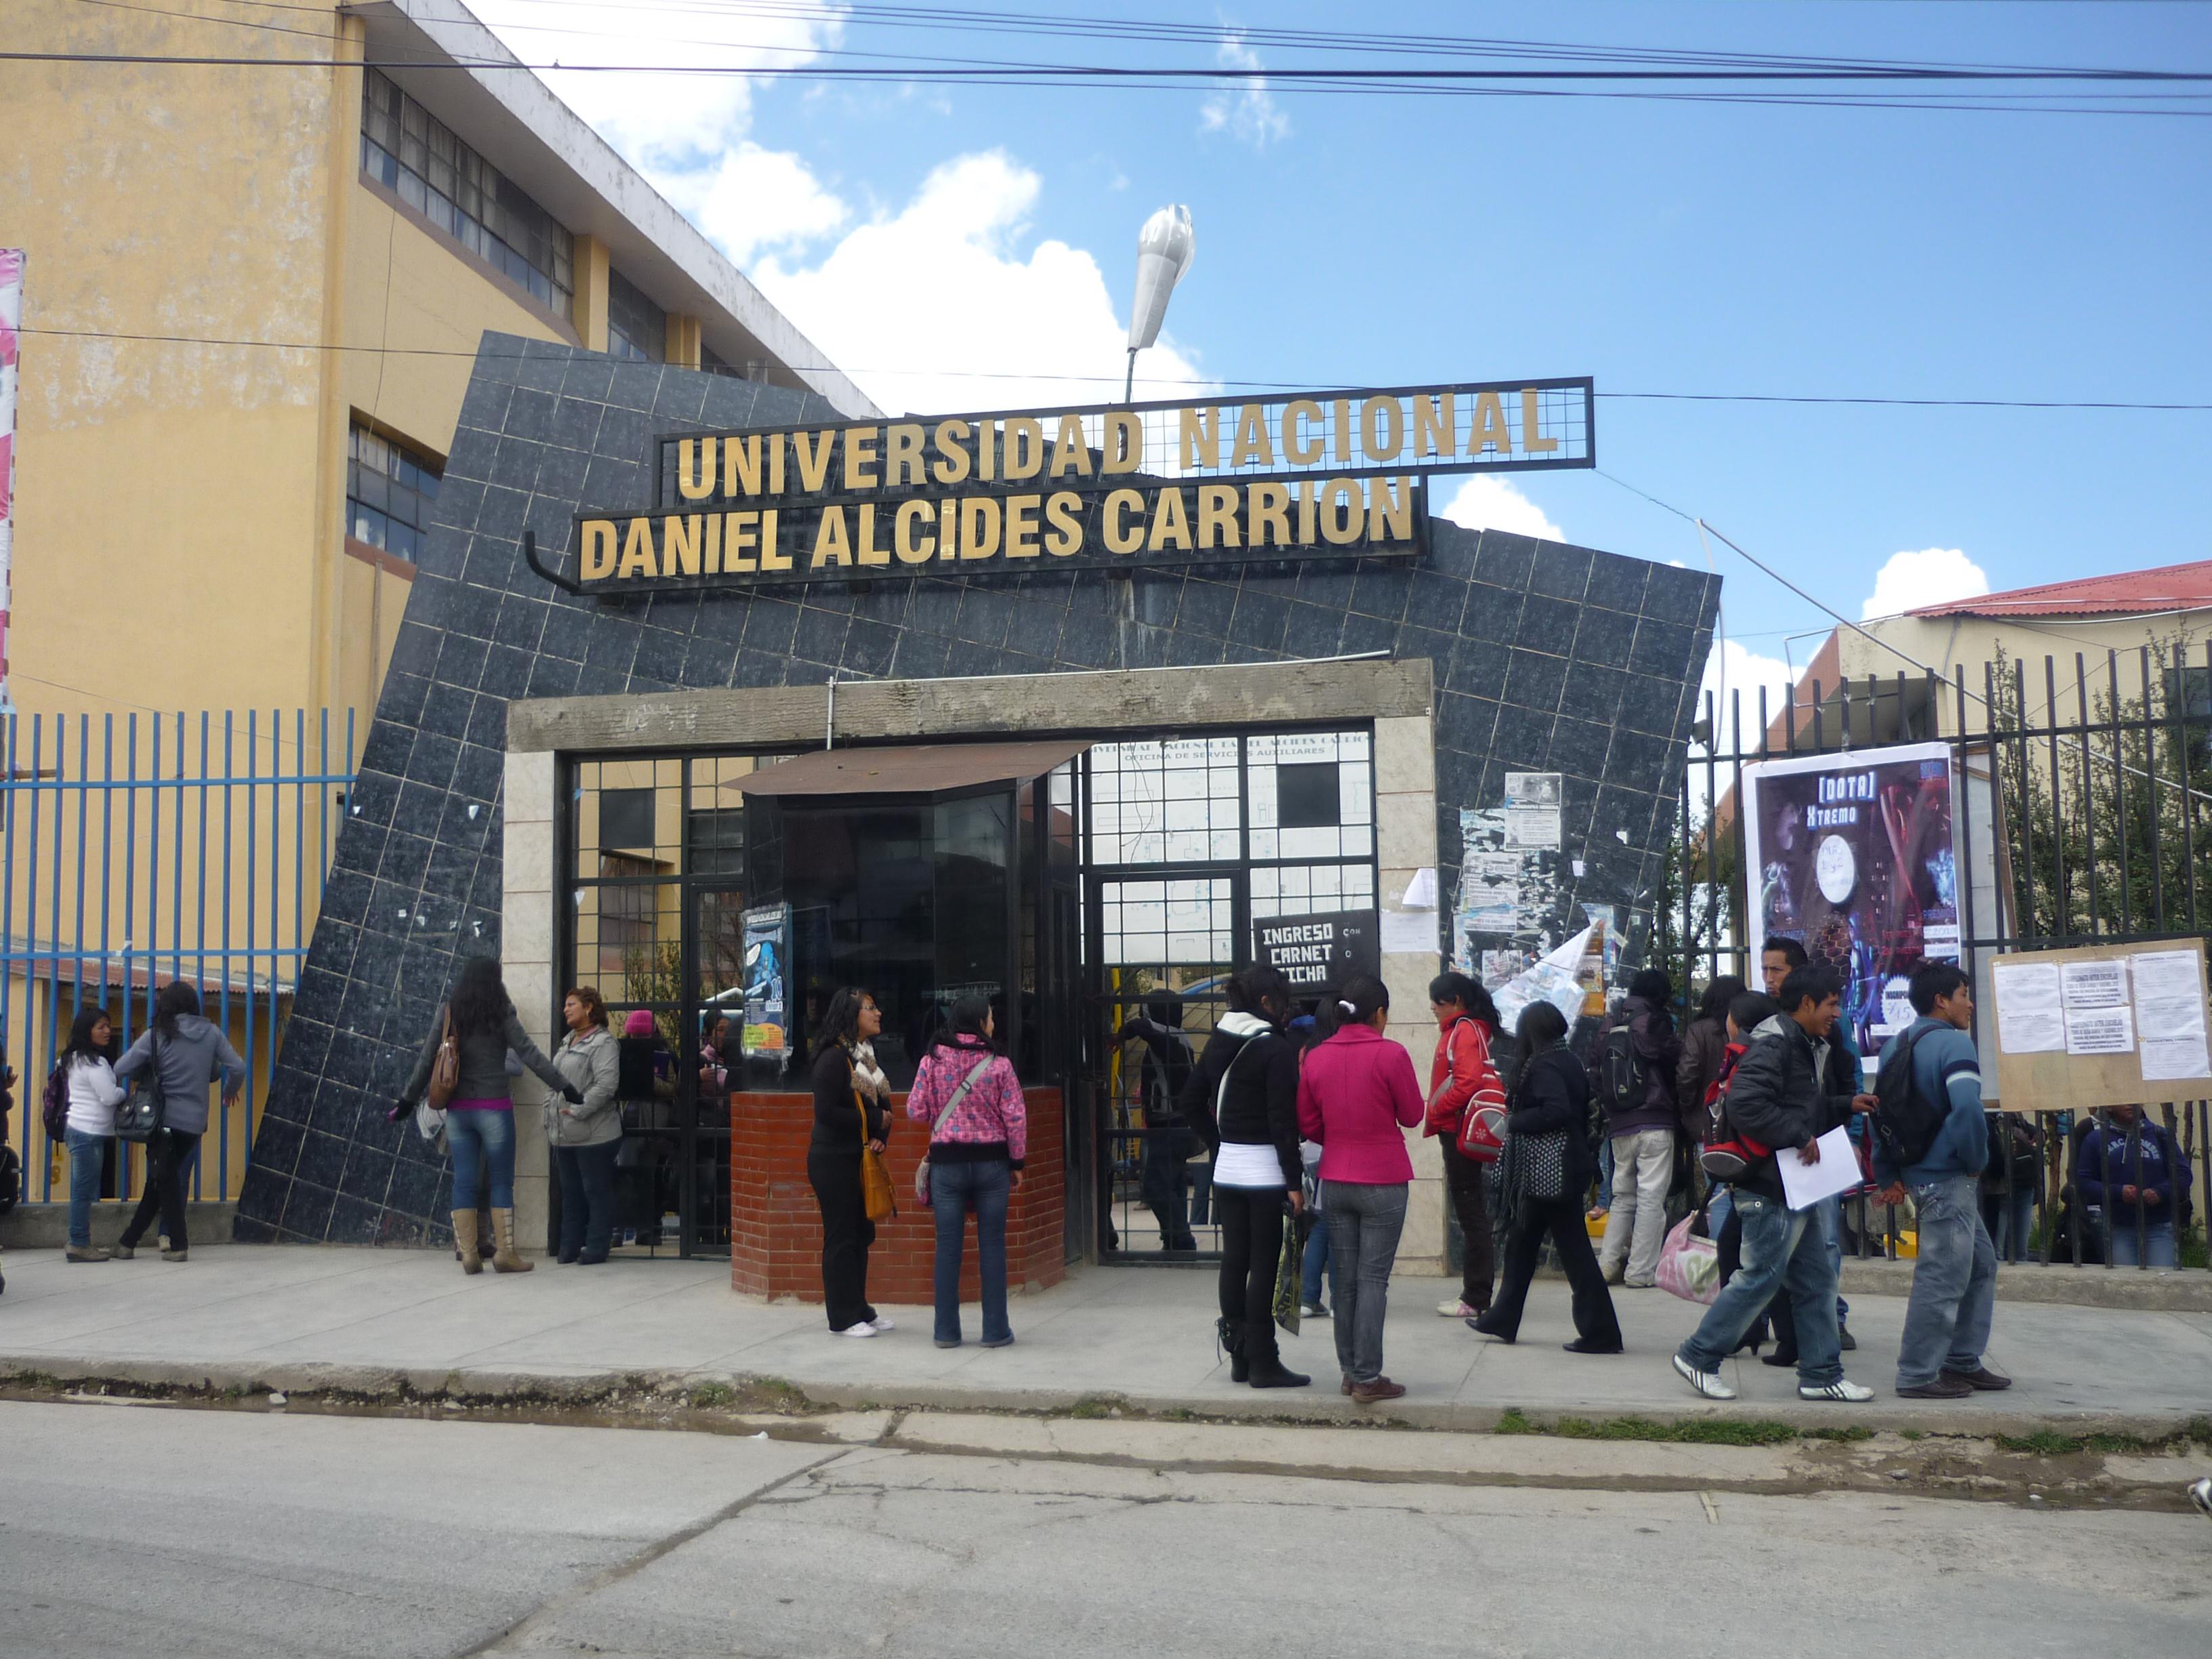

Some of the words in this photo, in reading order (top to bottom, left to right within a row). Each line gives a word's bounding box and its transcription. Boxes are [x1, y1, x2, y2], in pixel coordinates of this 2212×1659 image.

[678, 411, 1143, 499] UNIVERSIDAD
[1179, 387, 1558, 470] NACIONAL
[580, 509, 792, 581] DANIEL
[811, 491, 1083, 569] ALCIDES
[1102, 475, 1412, 554] CARRION
[1193, 750, 1252, 758] SERVICIS
[1257, 747, 1325, 756] AUXILIARES
[1263, 922, 1334, 945] INGRESO
[1270, 944, 1332, 964] CARNET
